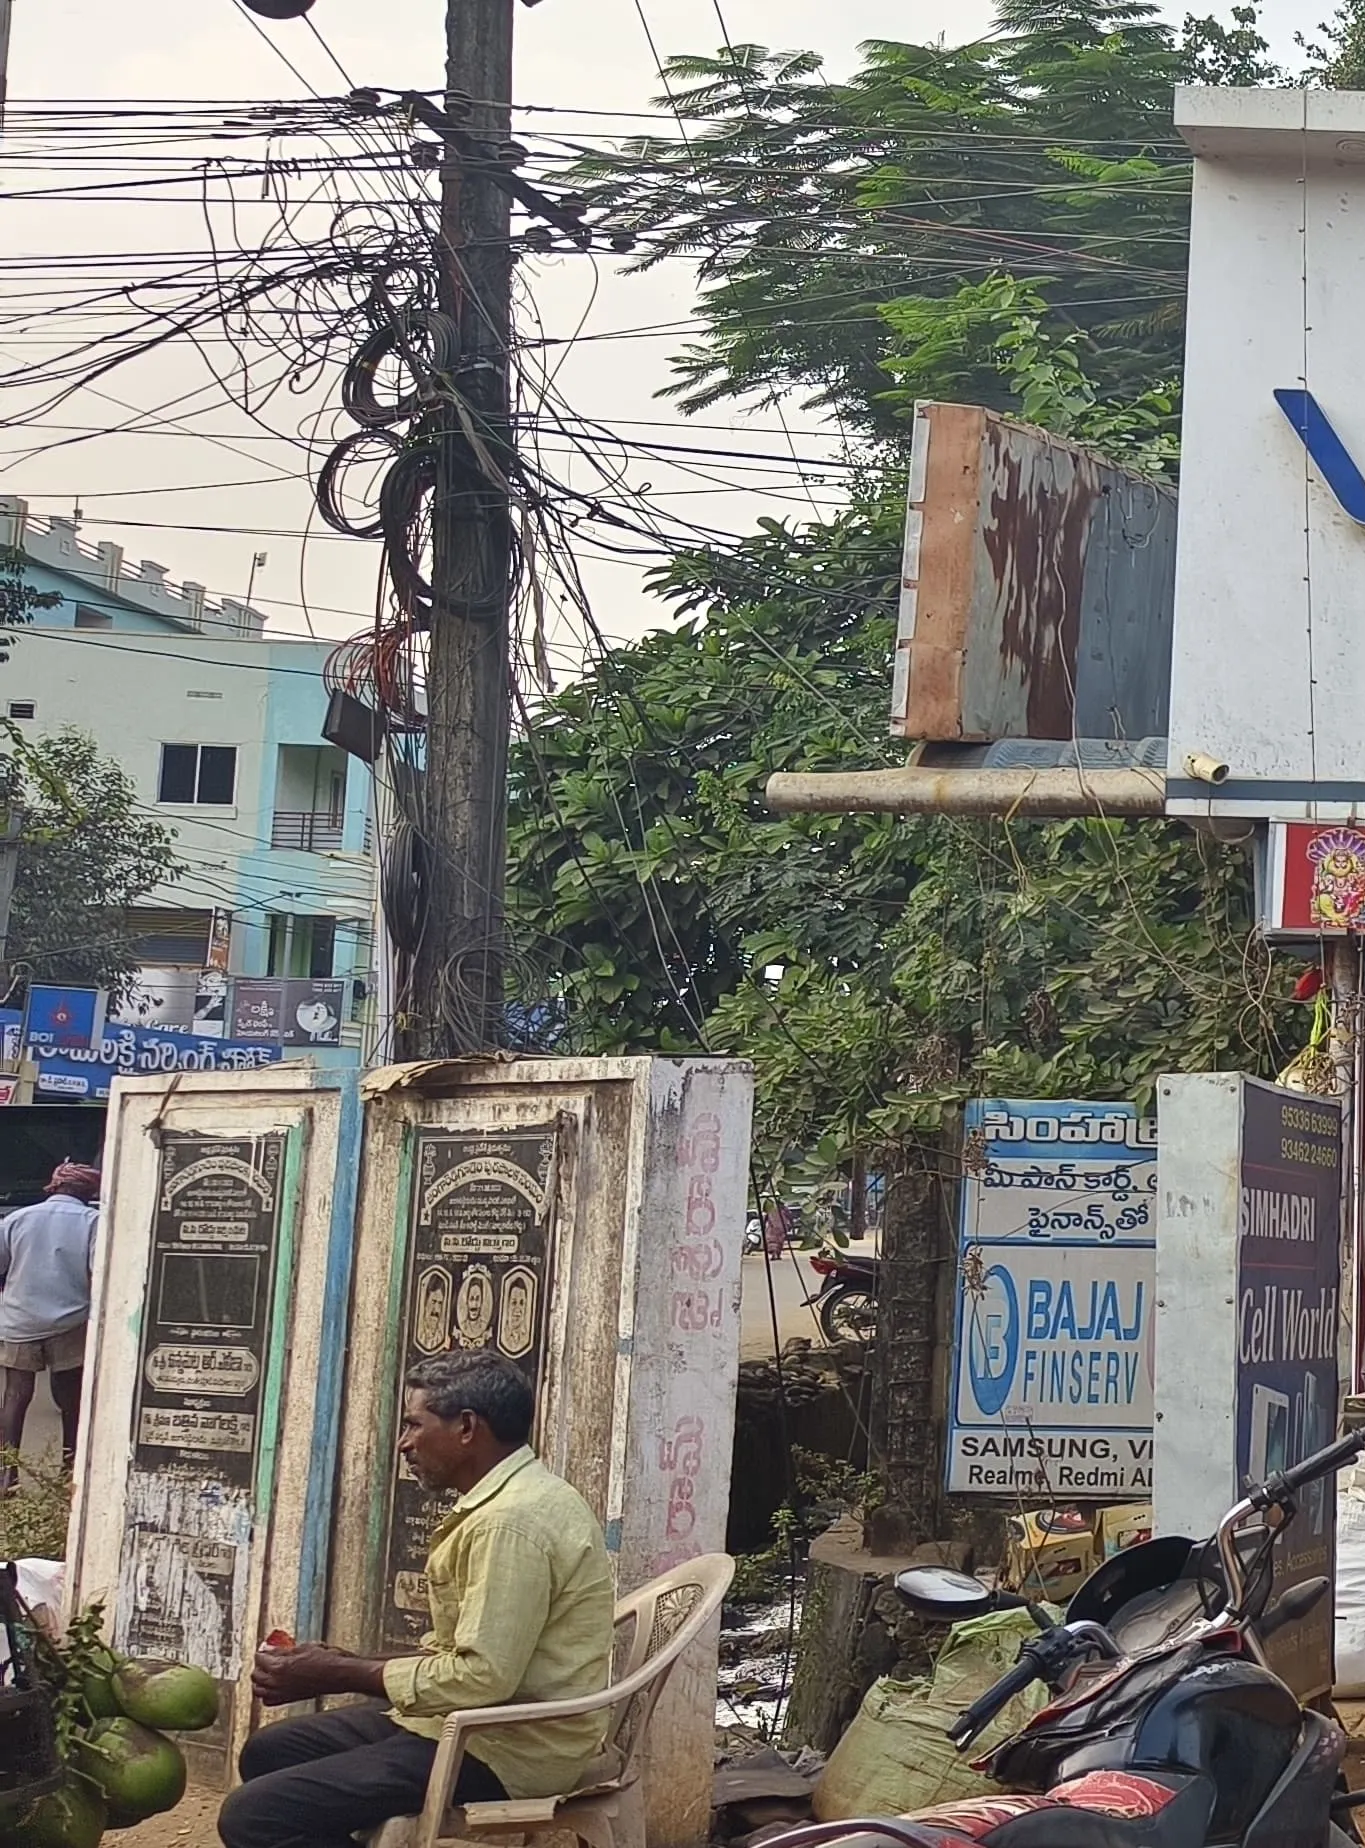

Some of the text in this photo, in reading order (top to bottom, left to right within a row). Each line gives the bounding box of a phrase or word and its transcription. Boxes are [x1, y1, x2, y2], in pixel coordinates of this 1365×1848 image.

[1281, 1105, 1338, 1137] 95336 63999
[1281, 1137, 1337, 1168] 93462 24660
[1240, 1186, 1316, 1242] SIMHADRI
[1027, 1279, 1144, 1341] BAJAJ
[1239, 1285, 1337, 1365] Cell World
[1023, 1350, 1140, 1404] FINSERV
[960, 1437, 1118, 1462] SAMSUNG,
[1058, 1467, 1125, 1487] Redmi
